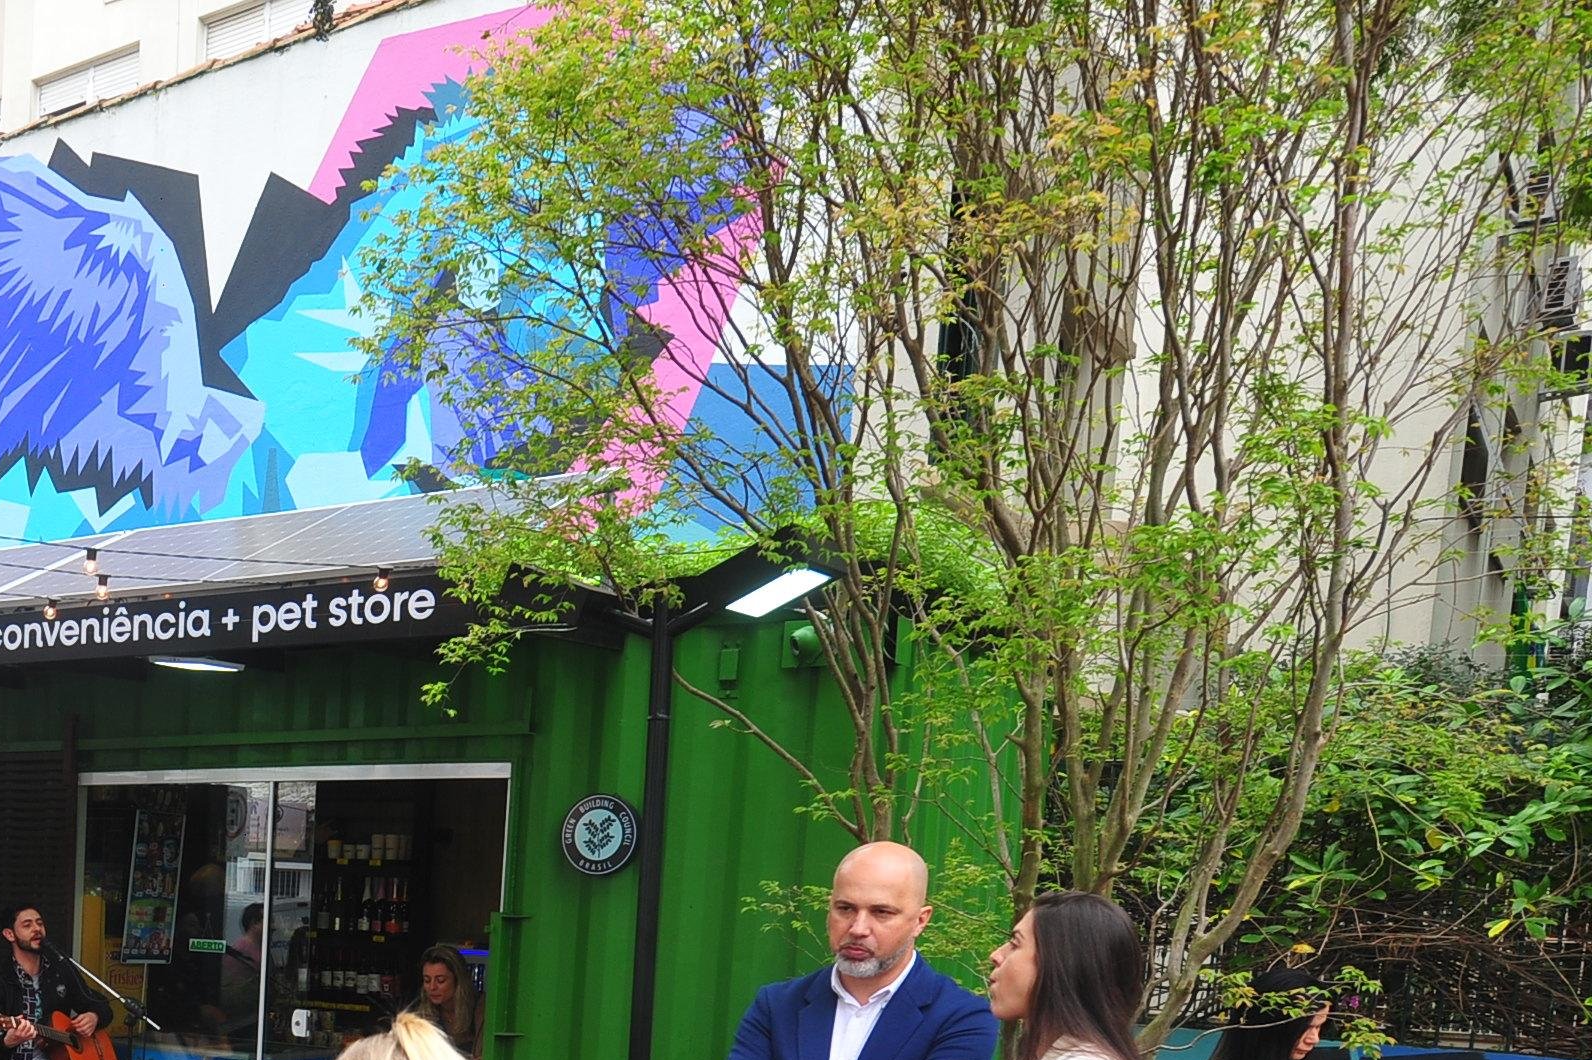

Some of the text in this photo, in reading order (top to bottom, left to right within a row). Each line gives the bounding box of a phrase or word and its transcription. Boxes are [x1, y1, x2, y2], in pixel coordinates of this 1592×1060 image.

[251, 592, 318, 643] pet
[328, 588, 436, 628] store
[578, 799, 615, 814] BUILDING
[564, 818, 576, 844] GREEN
[619, 811, 633, 846] COUNCIL
[578, 859, 613, 871] BRASIL
[189, 940, 226, 952] ABERTO
